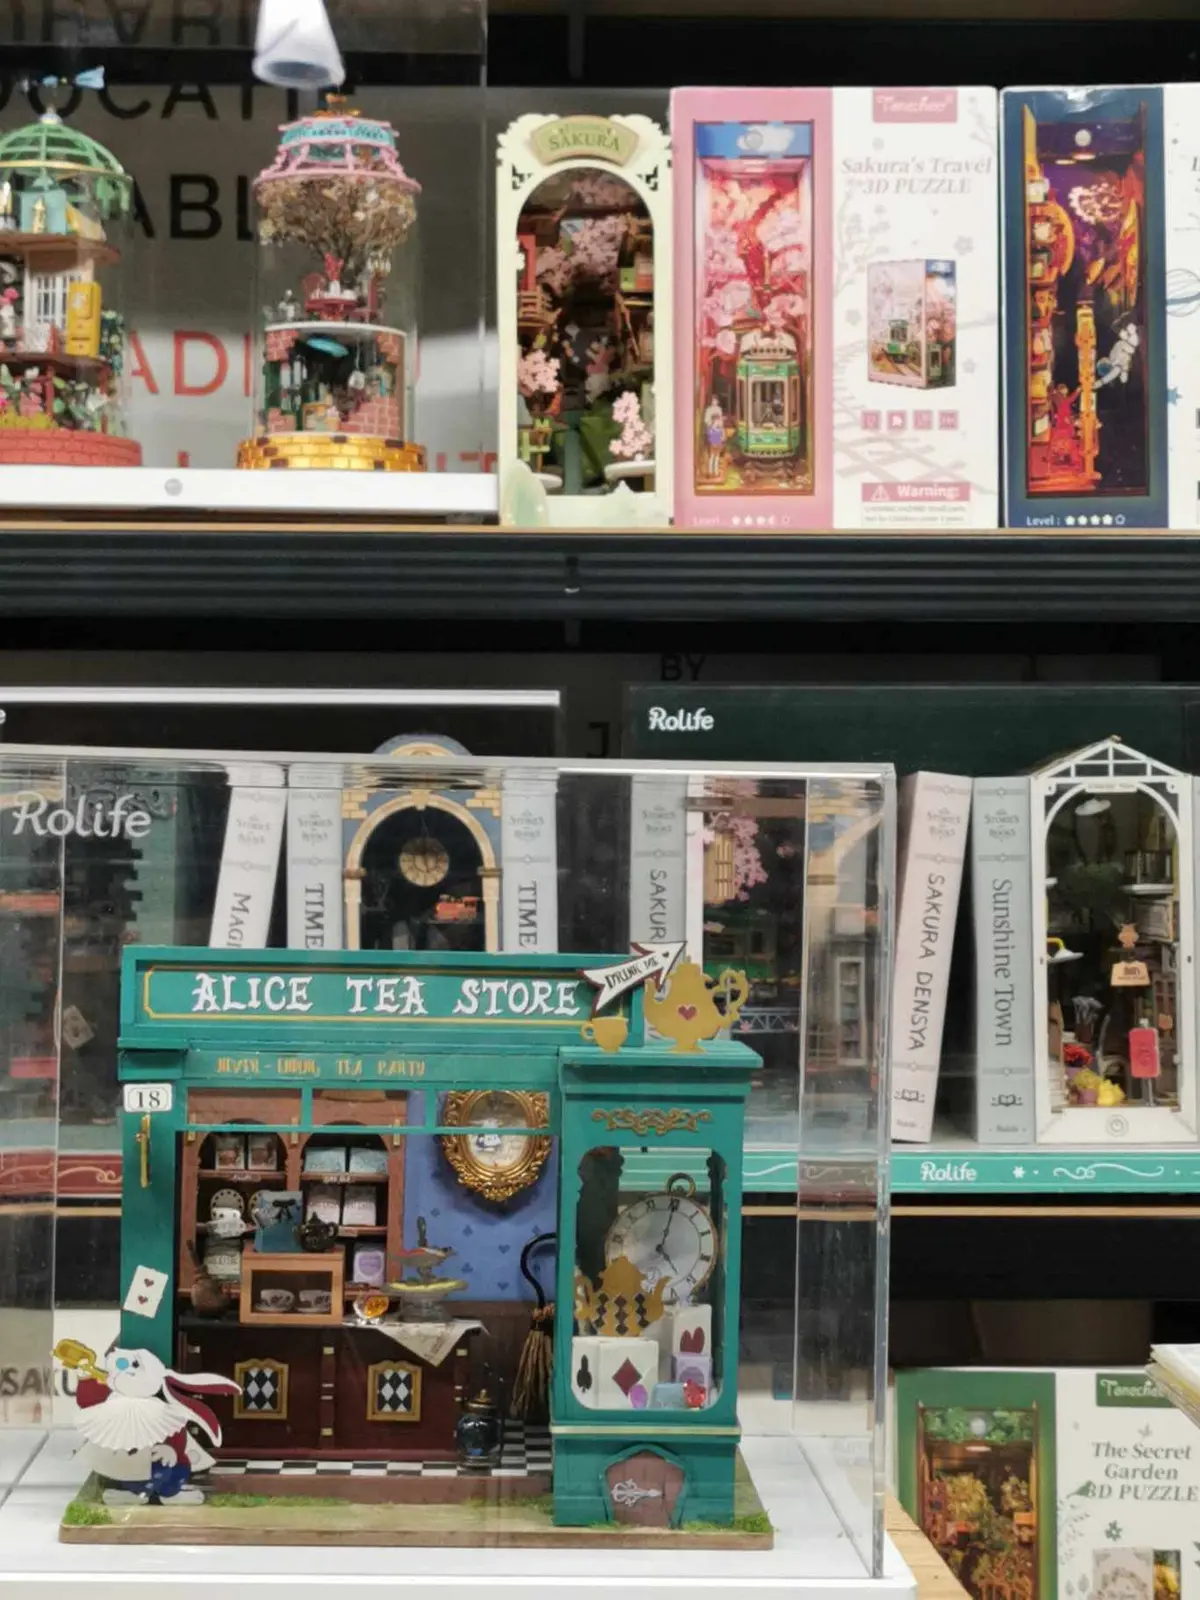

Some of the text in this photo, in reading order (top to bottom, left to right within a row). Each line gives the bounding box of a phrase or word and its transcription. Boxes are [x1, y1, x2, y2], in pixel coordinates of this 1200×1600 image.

[548, 131, 621, 151] SAKURA
[840, 155, 993, 174] Sakura's Travel
[861, 178, 972, 194] 3D PUZZLE
[647, 705, 715, 732] Rolife
[12, 790, 152, 837] Rolife
[304, 882, 325, 949] TIME
[518, 881, 538, 948] TIME
[907, 872, 946, 1051] SAKURA DENSYA
[992, 878, 1016, 1047] Sunshine Town
[191, 972, 581, 1016] ALICE TEA STORE
[136, 1090, 161, 1109] 18
[920, 1161, 978, 1182] Rolife
[1092, 1441, 1193, 1460] The Secret
[1104, 1462, 1179, 1481] Garden
[1119, 1483, 1200, 1501] PUZZLE
